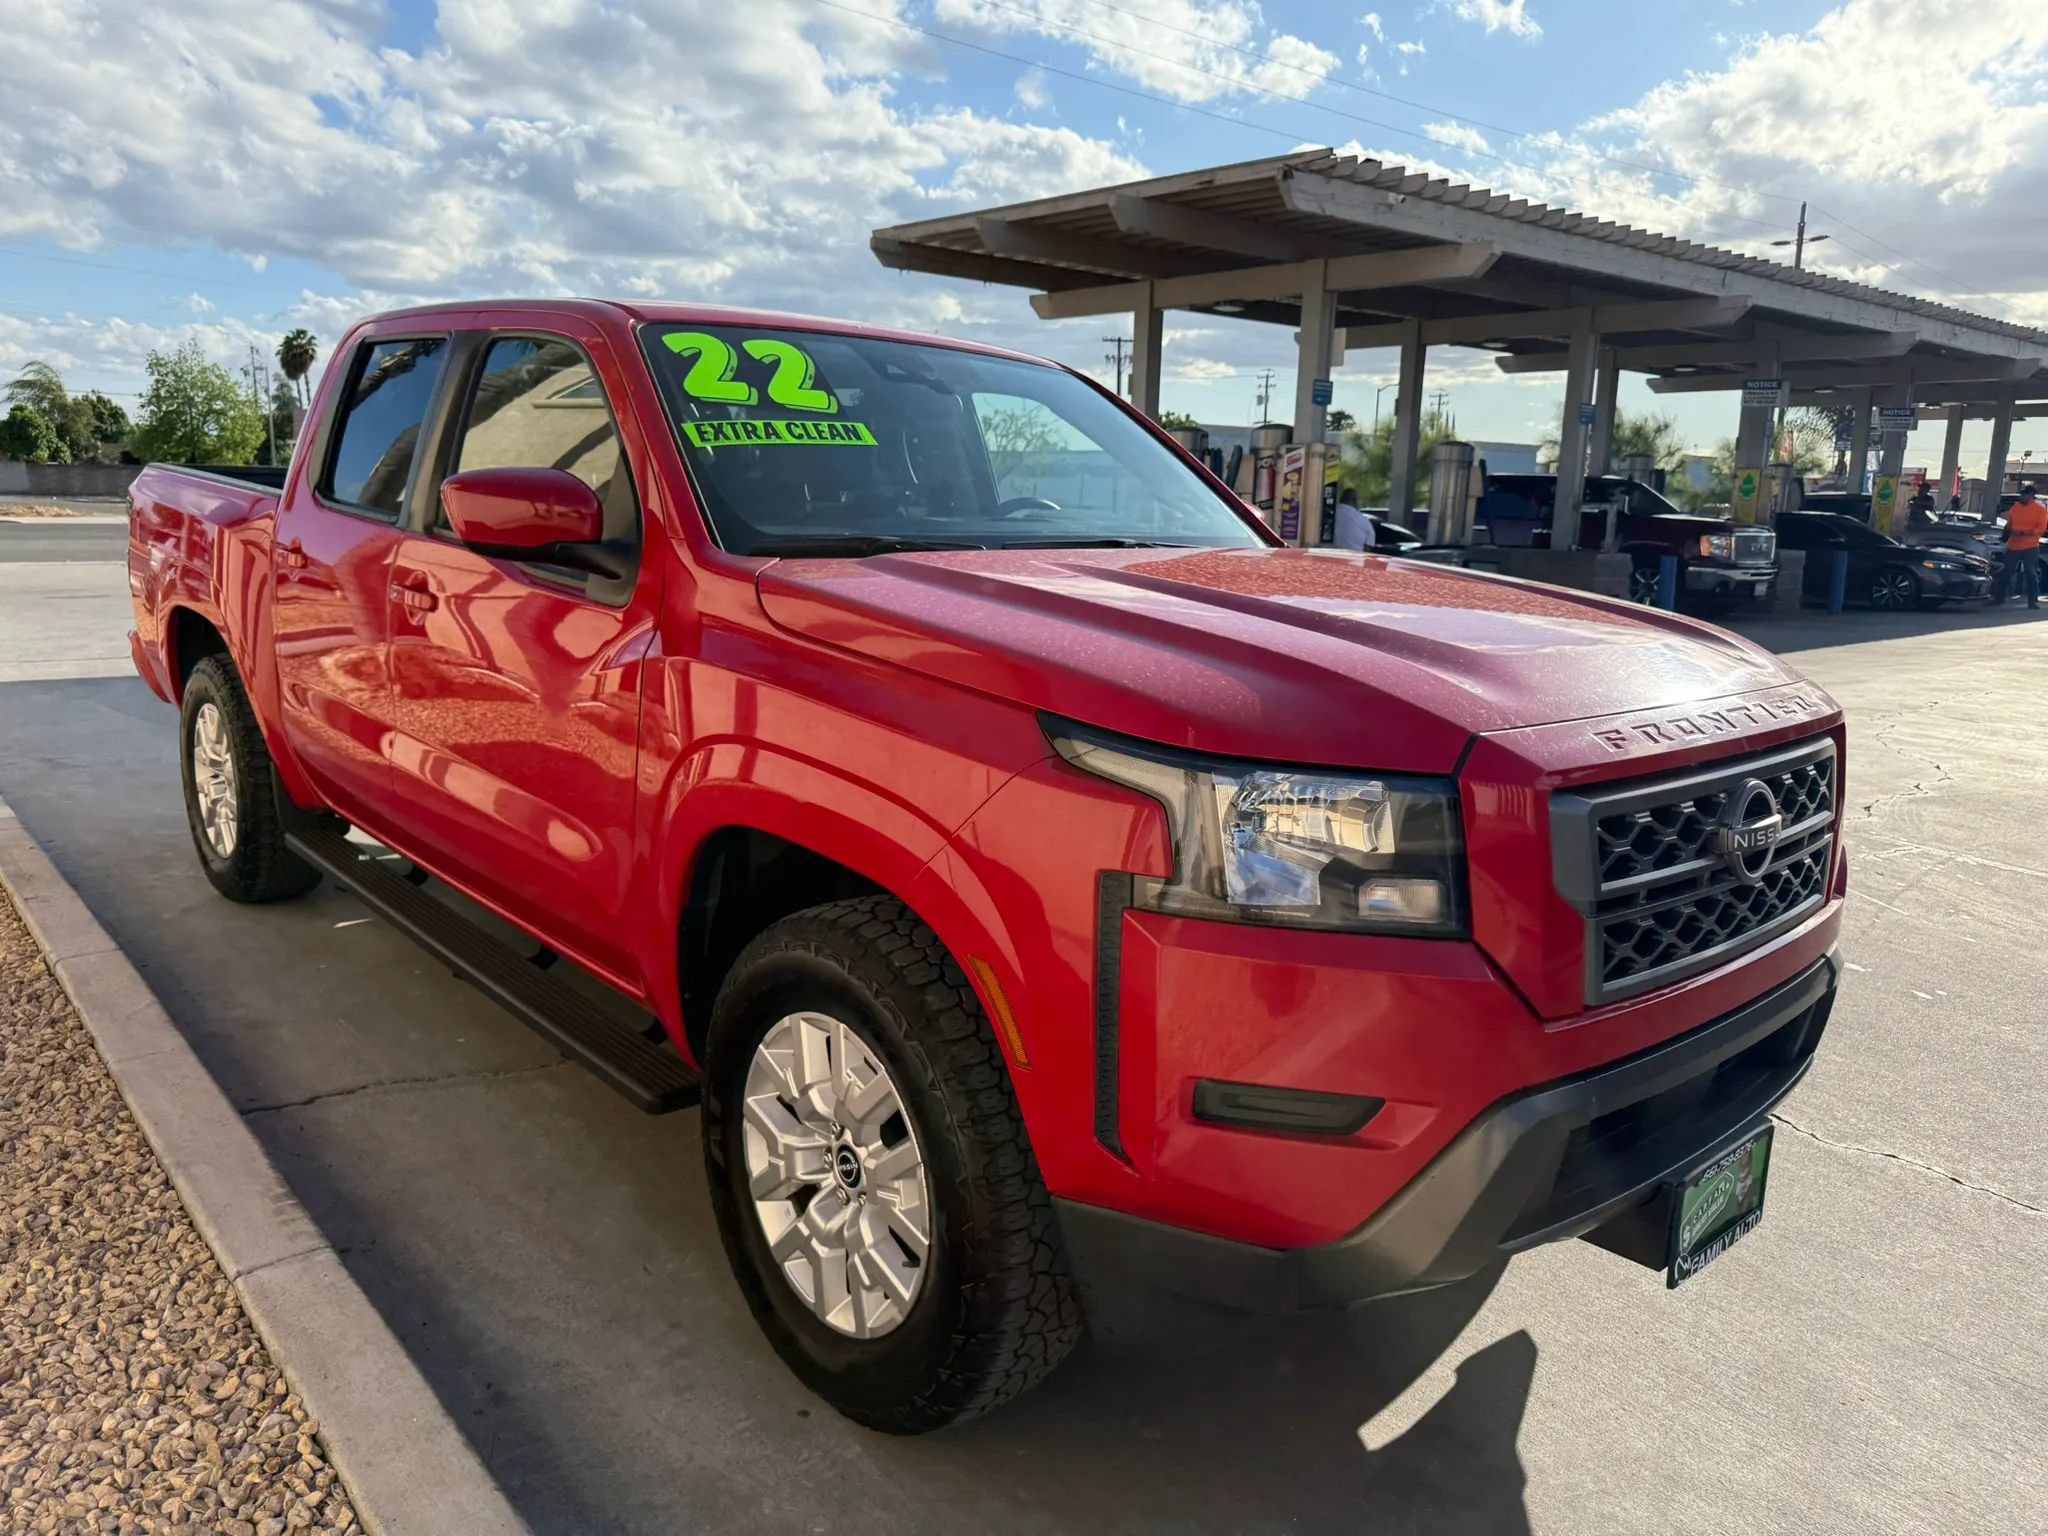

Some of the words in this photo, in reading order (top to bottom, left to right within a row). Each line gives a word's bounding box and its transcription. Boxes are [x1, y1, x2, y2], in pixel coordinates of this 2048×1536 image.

[661, 331, 839, 414] 22
[694, 422, 784, 442] EXTRA
[784, 421, 863, 441] CLEAN
[1591, 695, 1817, 753] FRONTIER
[1734, 827, 1779, 849] NISS
[1690, 1231, 1733, 1277] FAMILY
[1734, 1210, 1761, 1243] AUTO
